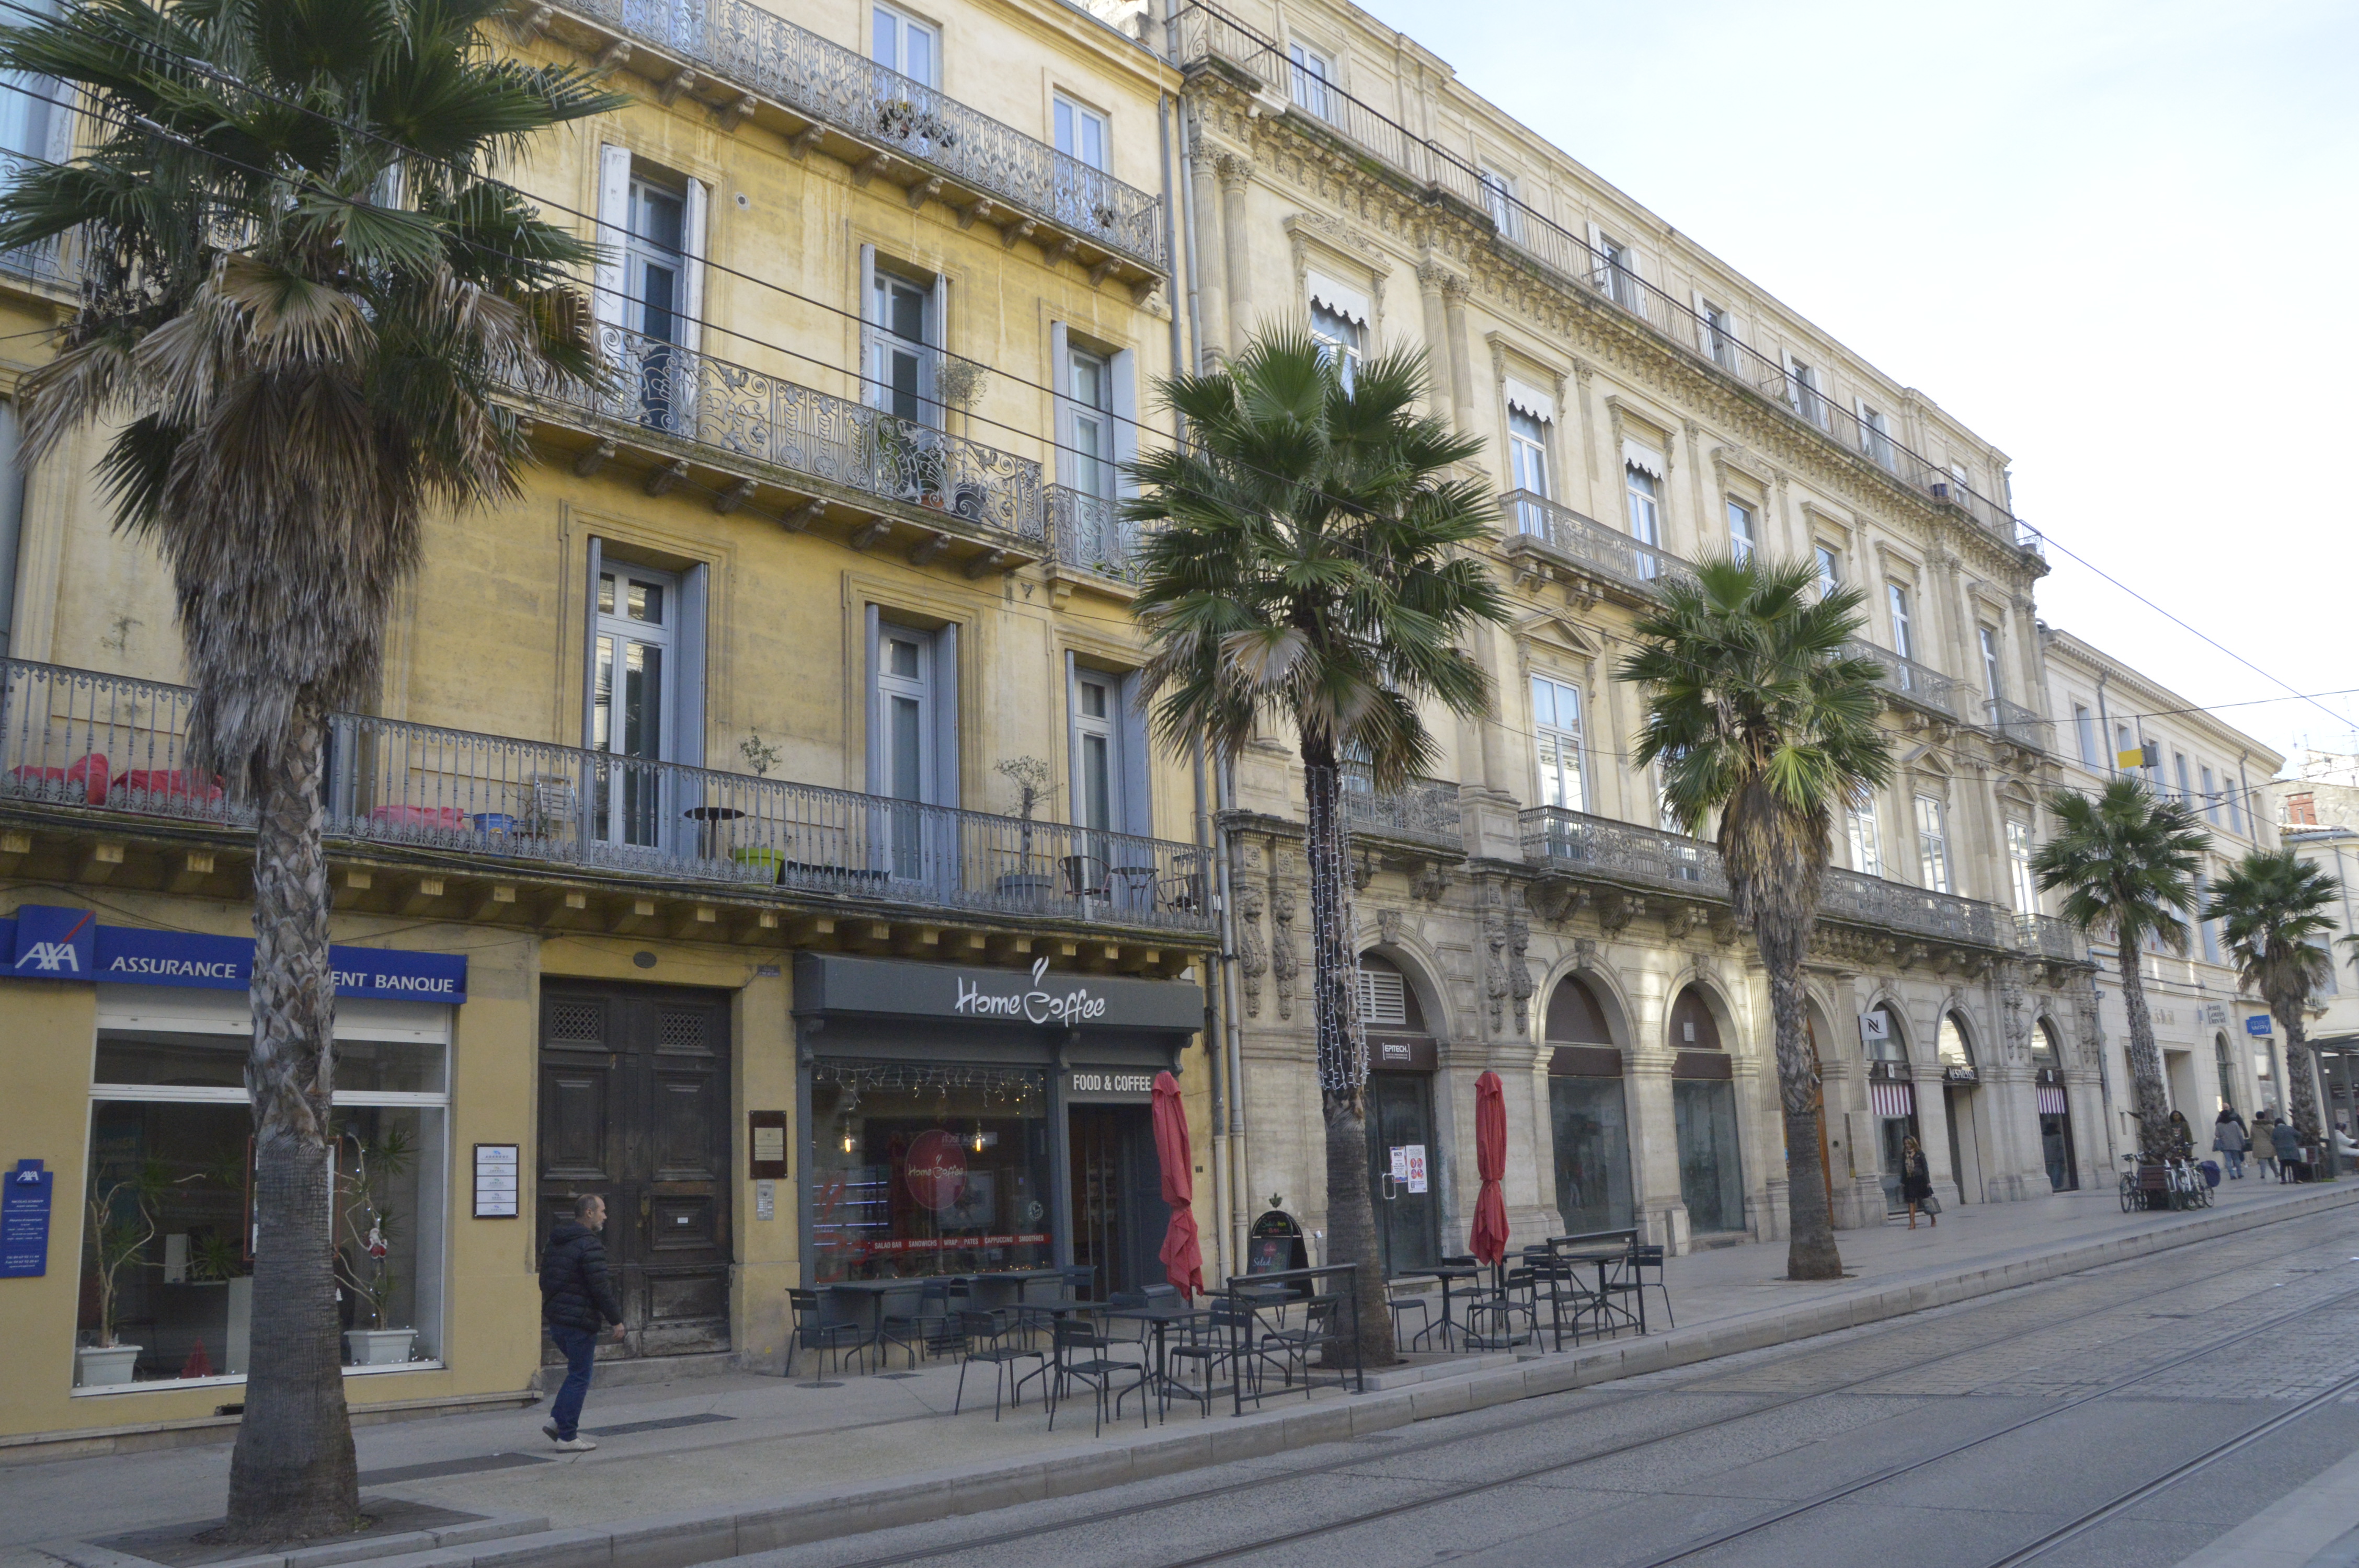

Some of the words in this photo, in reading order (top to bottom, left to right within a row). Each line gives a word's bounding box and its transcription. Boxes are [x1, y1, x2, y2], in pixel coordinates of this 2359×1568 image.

[14, 941, 79, 973] AXA
[109, 956, 237, 979] ASSURANCE
[374, 975, 454, 993] BANQUE
[954, 976, 1021, 1015] Home
[1024, 989, 1105, 1028] Coffee
[1949, 1067, 1975, 1080] NESPRESSO
[1073, 1074, 1101, 1091] FOOD
[1103, 1076, 1112, 1091] &
[1114, 1076, 1152, 1092] COFFEE
[17, 1171, 39, 1181] AXA
[908, 1165, 932, 1177] Home
[933, 1165, 964, 1179] Coffee
